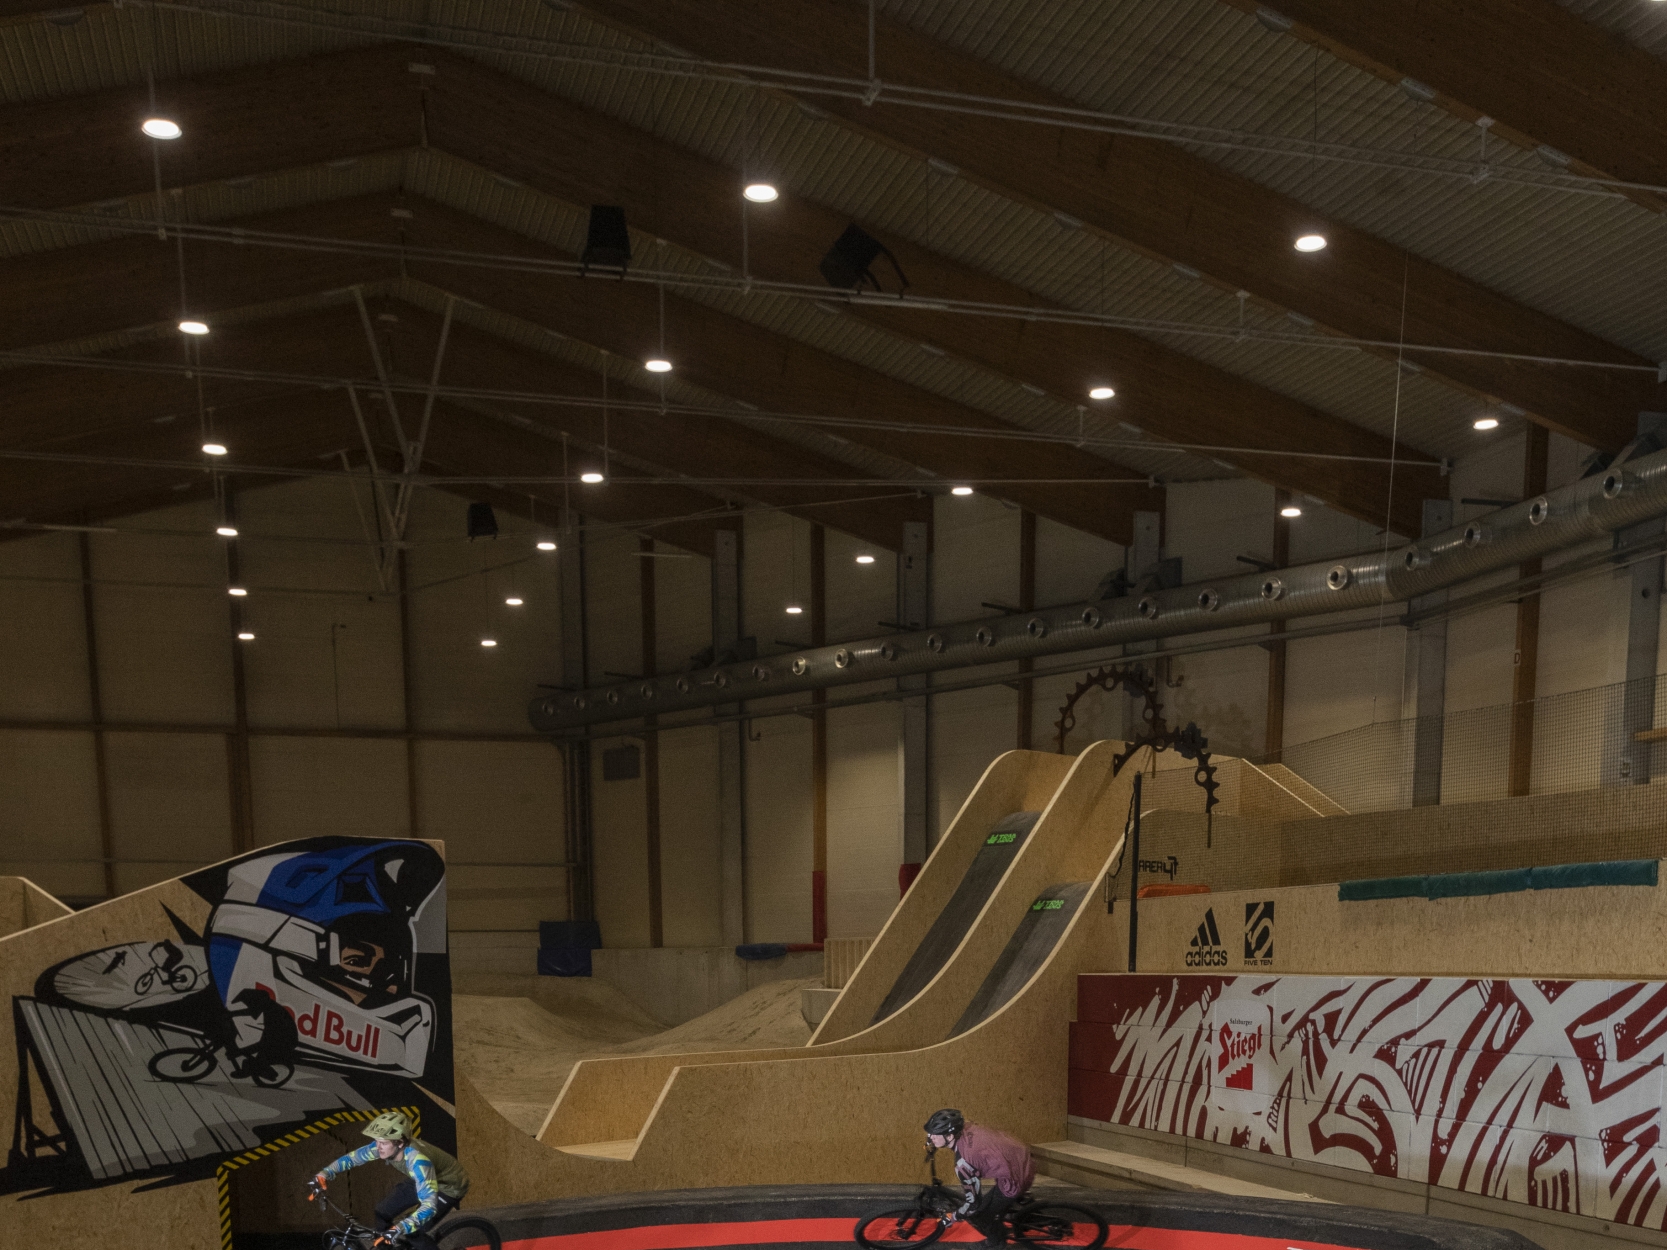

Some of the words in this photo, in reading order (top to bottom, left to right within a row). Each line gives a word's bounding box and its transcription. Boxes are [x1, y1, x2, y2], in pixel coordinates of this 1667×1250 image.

[1185, 945, 1228, 967] adidas
[323, 1009, 381, 1059] Bull
[1218, 1022, 1262, 1074] Stiegl
